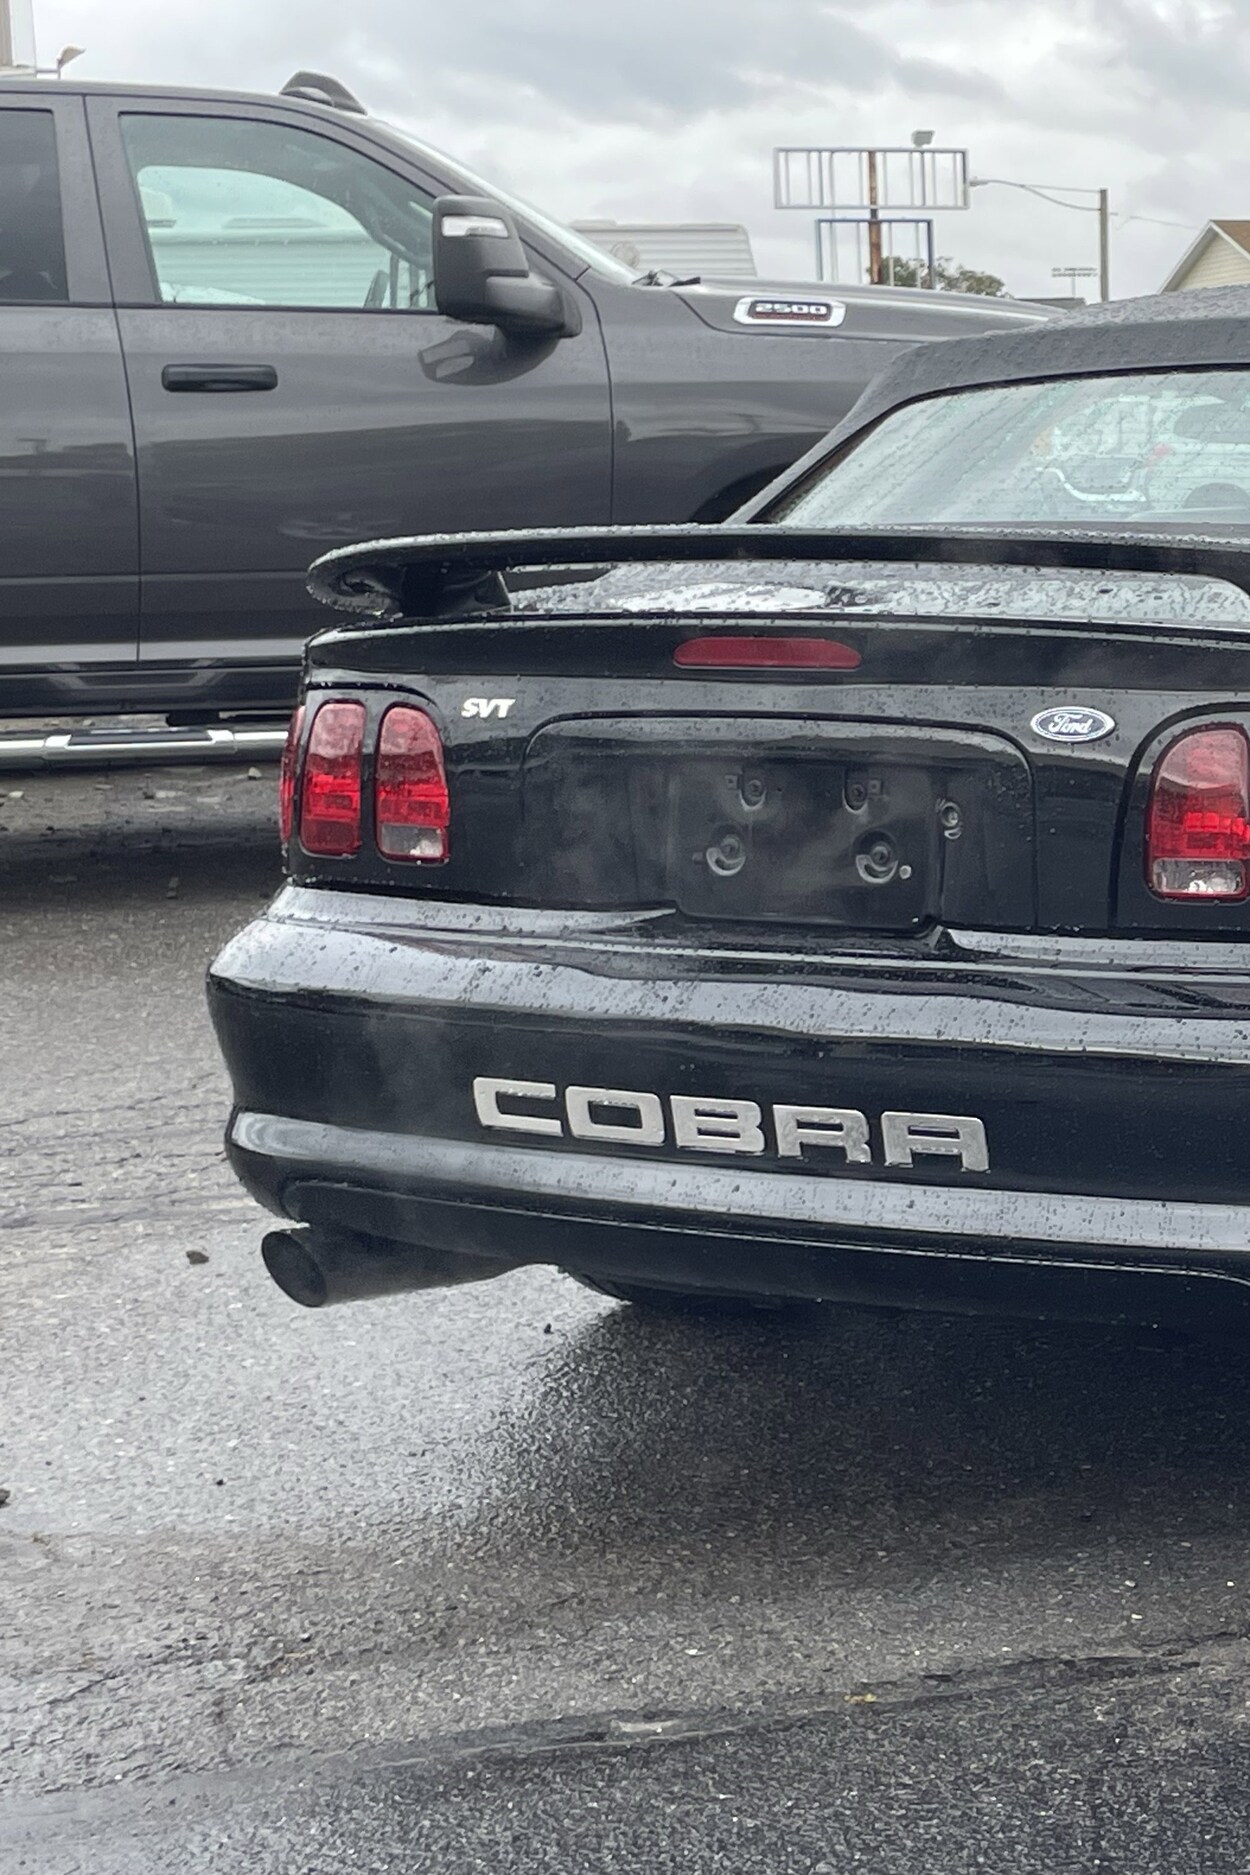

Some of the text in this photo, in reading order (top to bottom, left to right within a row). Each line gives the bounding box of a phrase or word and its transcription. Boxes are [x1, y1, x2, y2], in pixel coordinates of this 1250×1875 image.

[755, 303, 828, 315] 2500
[461, 698, 516, 719] SVT
[473, 1077, 991, 1173] COBRA
